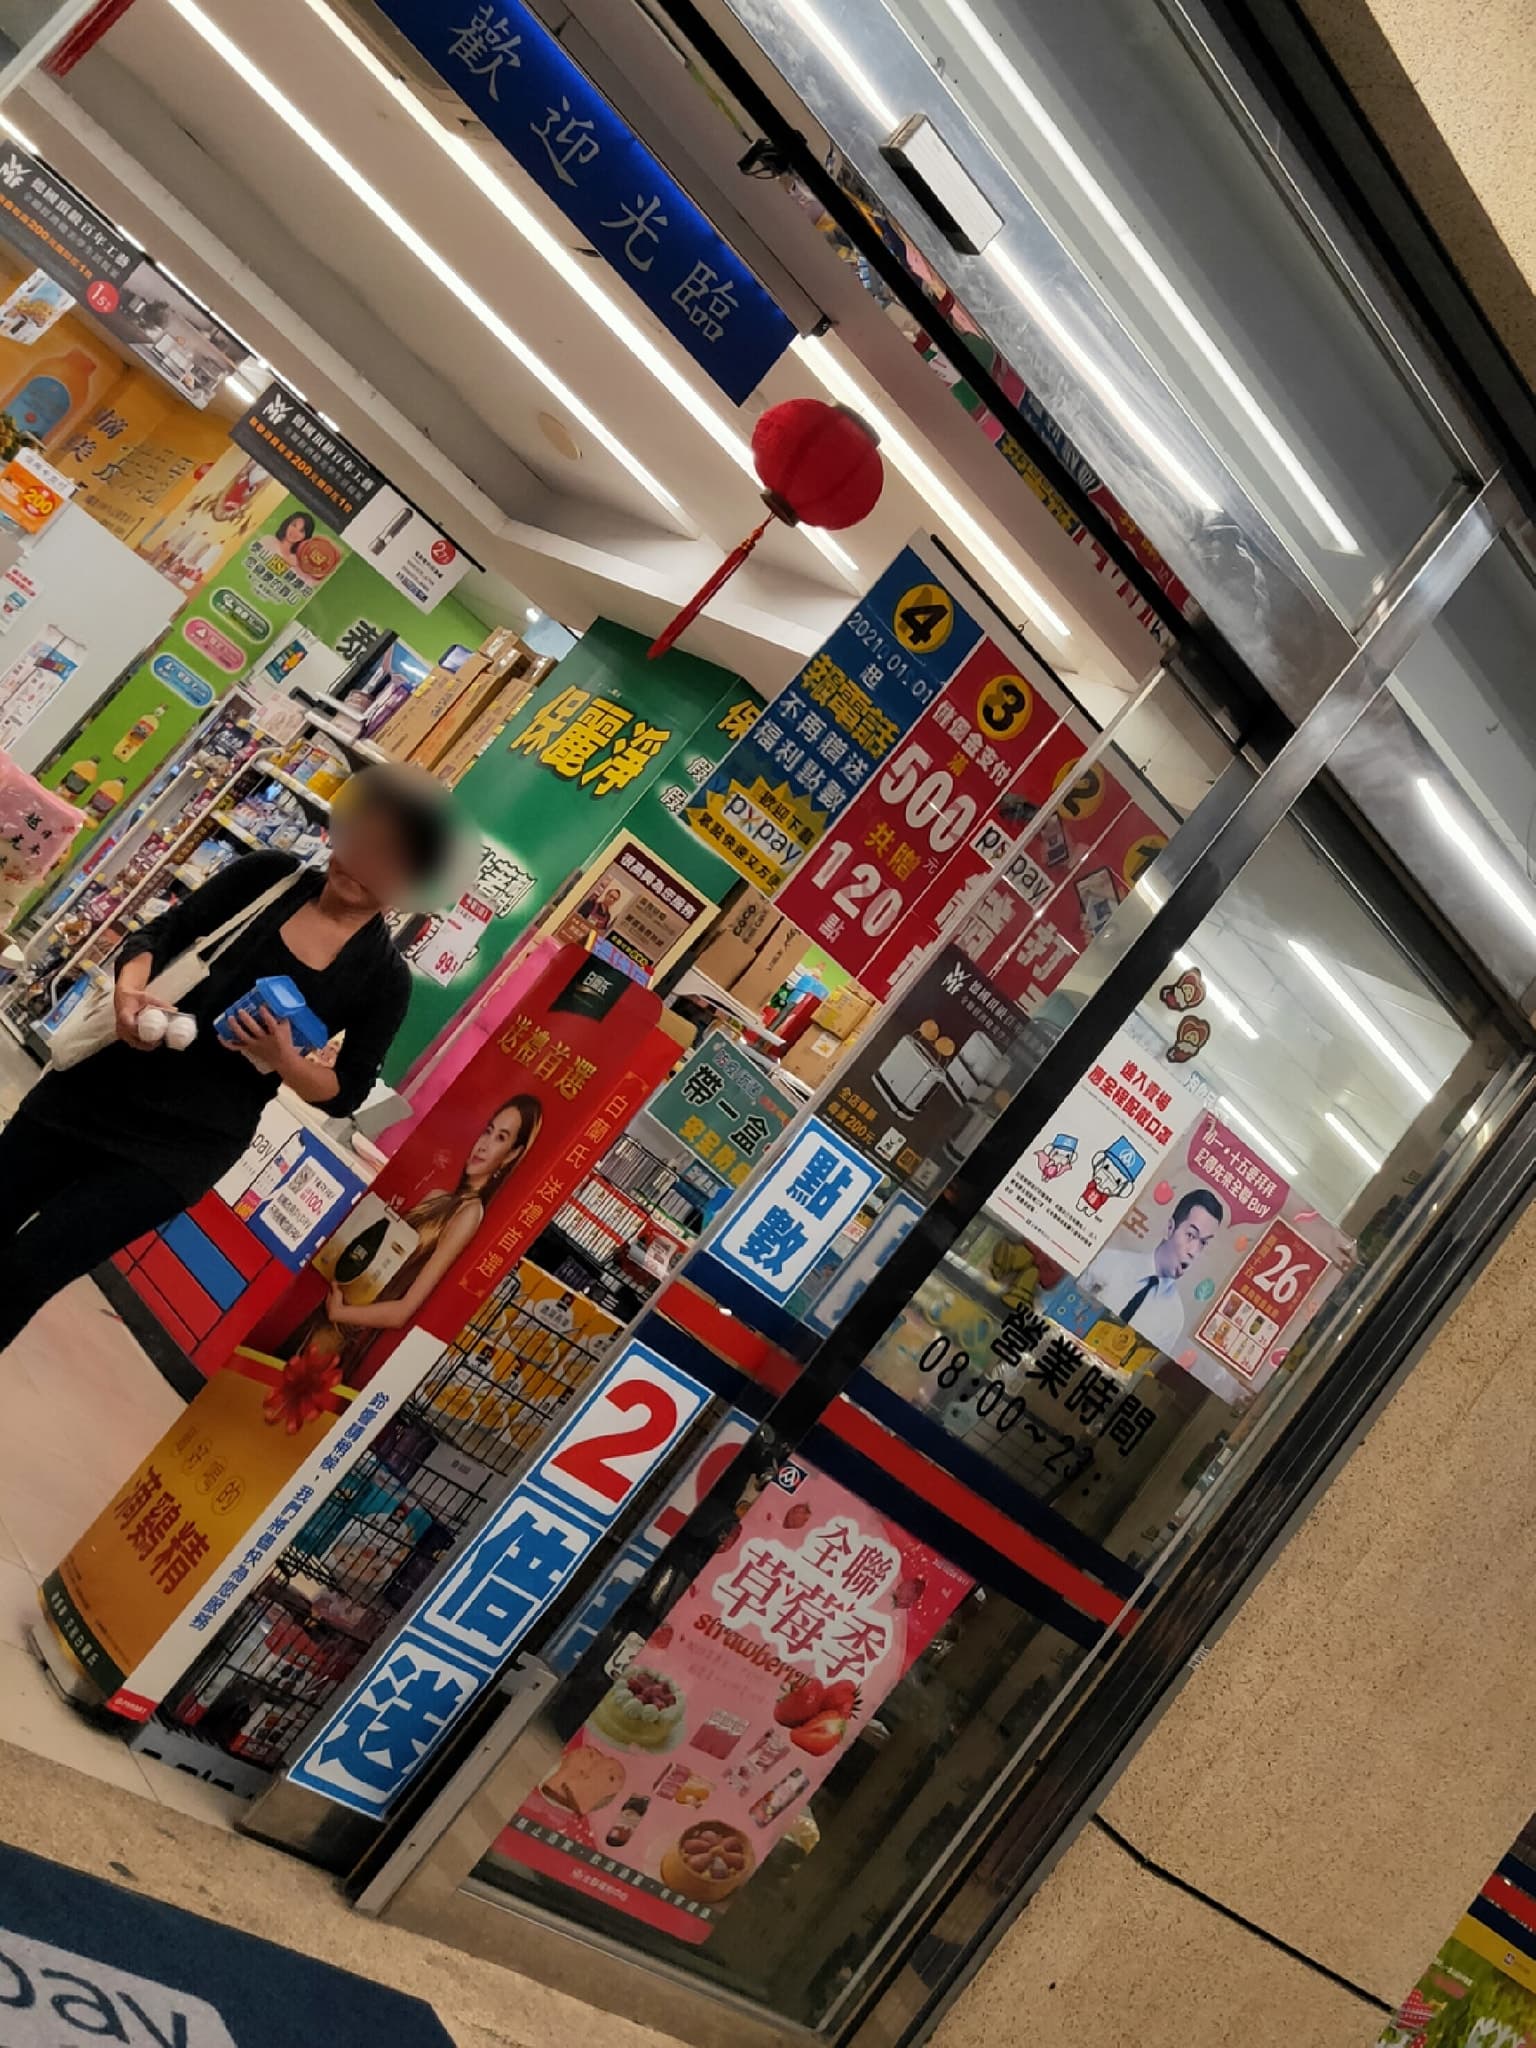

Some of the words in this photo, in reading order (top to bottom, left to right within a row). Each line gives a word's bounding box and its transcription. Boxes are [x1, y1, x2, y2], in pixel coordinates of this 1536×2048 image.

[446, 4, 739, 343] 歡迎光臨
[847, 610, 935, 706] 2021.01.01
[898, 603, 949, 646] 4
[801, 653, 902, 761] 報電話
[859, 661, 887, 692] 起
[981, 683, 1027, 733] 3
[508, 684, 672, 798] 保麗淨
[752, 719, 848, 813] 福利點數
[779, 691, 871, 787] 不再贈送
[758, 790, 817, 847] 歡迎下載
[878, 742, 977, 853] 500
[811, 840, 905, 937] 120
[864, 822, 923, 882] 共贈
[921, 857, 944, 875] 元
[817, 912, 847, 945] 點
[495, 1012, 600, 1102] 送禮首選
[1118, 1059, 1173, 1114] 進入賣場
[564, 1093, 630, 1170] 白蘭氏
[680, 1063, 770, 1157] 帶一盒
[1087, 1063, 1175, 1148] 應全程配戴口罩
[473, 1174, 566, 1280] 送禮首選
[739, 1146, 854, 1277] 點數
[1251, 1244, 1311, 1304] 26
[990, 1300, 1157, 1457] 營業時間
[113, 1464, 212, 1595] 滴雞精
[802, 1522, 894, 1600] 全聯
[718, 1547, 886, 1681] 草莓季
